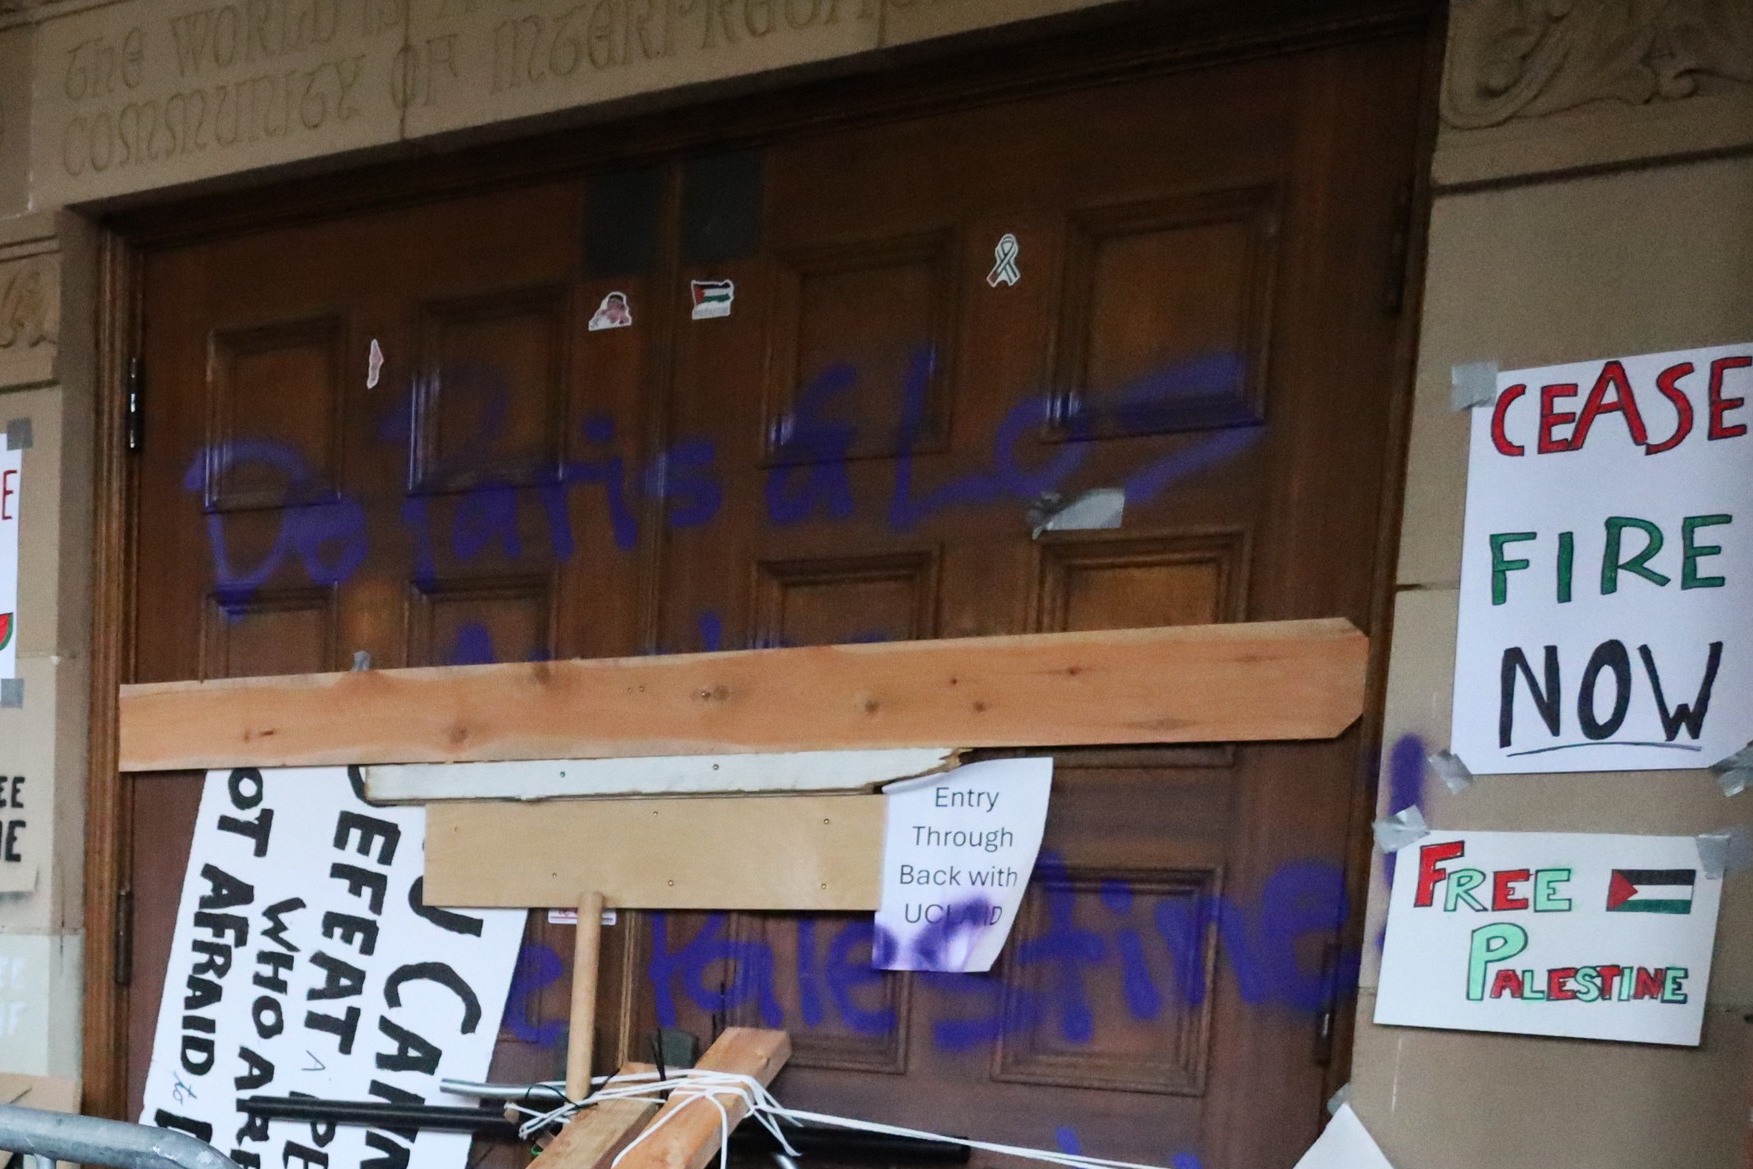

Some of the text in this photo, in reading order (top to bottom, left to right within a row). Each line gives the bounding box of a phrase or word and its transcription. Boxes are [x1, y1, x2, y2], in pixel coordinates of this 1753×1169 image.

[1490, 356, 1753, 457] CEASE
[1488, 513, 1734, 606] FIRE
[1498, 638, 1725, 749] NOW
[216, 767, 275, 858] OT
[912, 826, 1014, 853] Through
[935, 787, 999, 813] Entry
[899, 865, 1018, 887] Back with
[1414, 840, 1573, 913] FREE
[179, 863, 255, 1076] AFRAID
[250, 897, 308, 1039] WHO
[1466, 922, 1689, 1004] PALESTINE
